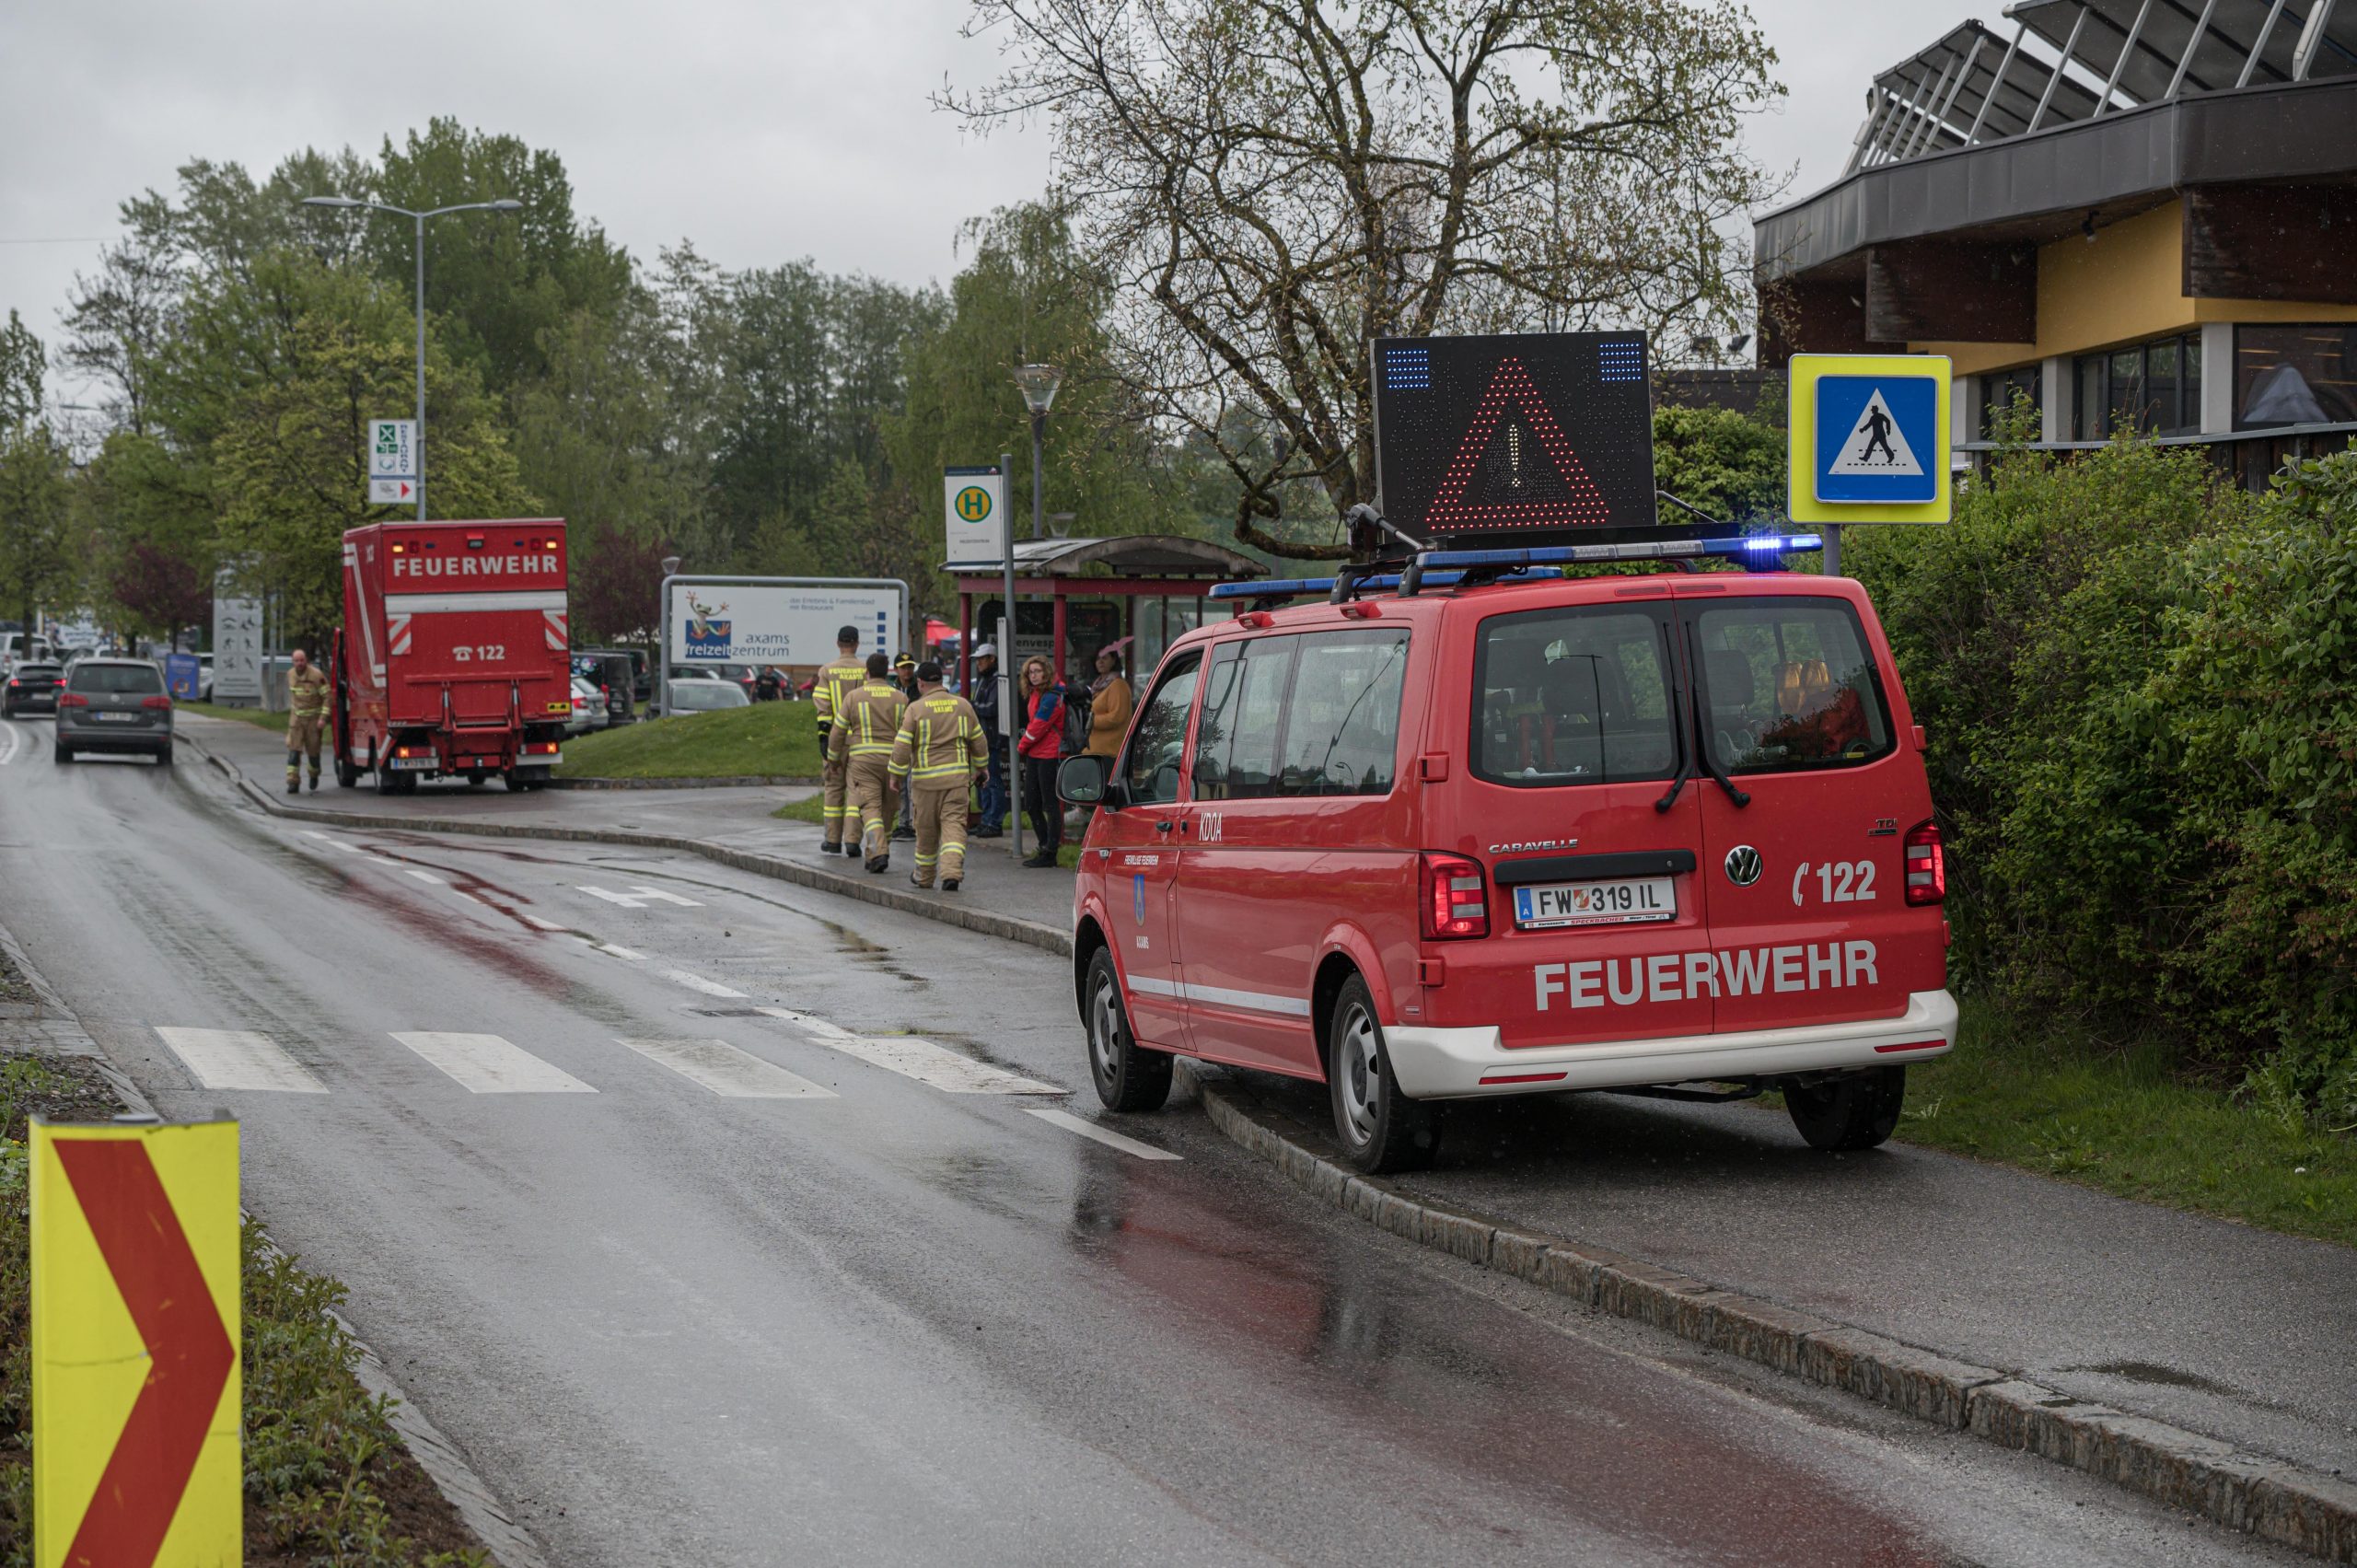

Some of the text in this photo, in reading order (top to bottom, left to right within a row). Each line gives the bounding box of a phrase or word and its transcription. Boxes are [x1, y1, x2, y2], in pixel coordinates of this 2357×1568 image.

[964, 493, 982, 516] H
[393, 555, 558, 577] FEUERWEHR
[745, 633, 790, 645] axams
[477, 645, 505, 660] 122
[1875, 818, 1898, 829] TDI
[1488, 839, 1579, 854] CARAVELLE
[1816, 860, 1876, 903] 122
[1538, 884, 1661, 915] FW 319 IL
[1570, 916, 1625, 925] SPECKBACHER
[1534, 939, 1879, 1011] FEUERWEHR
